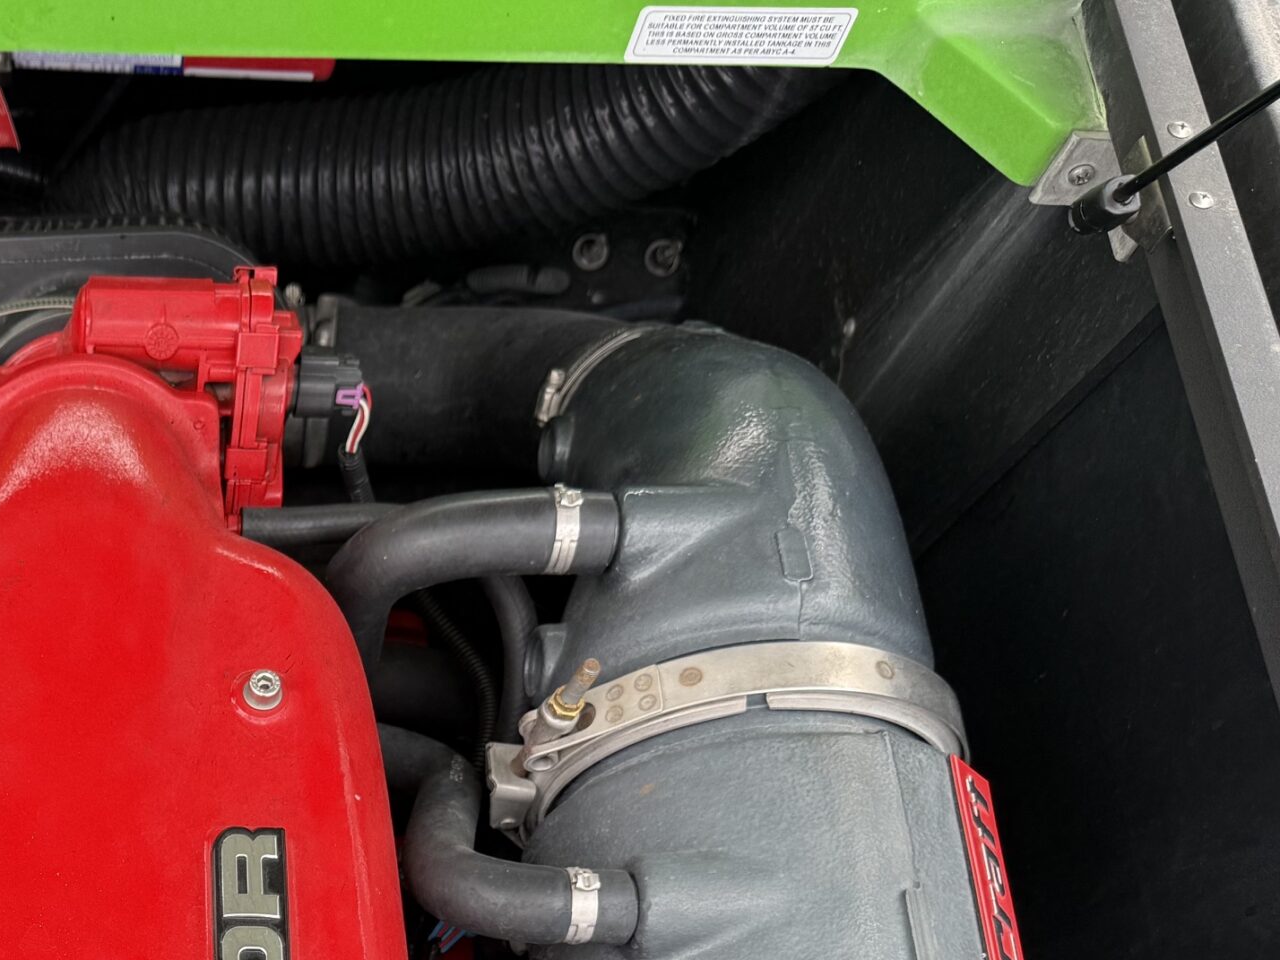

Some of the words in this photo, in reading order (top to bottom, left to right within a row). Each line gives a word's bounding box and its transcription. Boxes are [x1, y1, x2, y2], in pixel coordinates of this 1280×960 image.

[767, 15, 800, 23] SYSTEM
[686, 22, 702, 30] FOR
[703, 23, 762, 31] COMPARTMENT
[715, 31, 744, 39] GROSS
[804, 32, 837, 40] VOLUME
[646, 38, 666, 46] LESS
[723, 39, 766, 47] INSTALLED
[813, 40, 832, 48] THIS
[731, 47, 743, 55] AS
